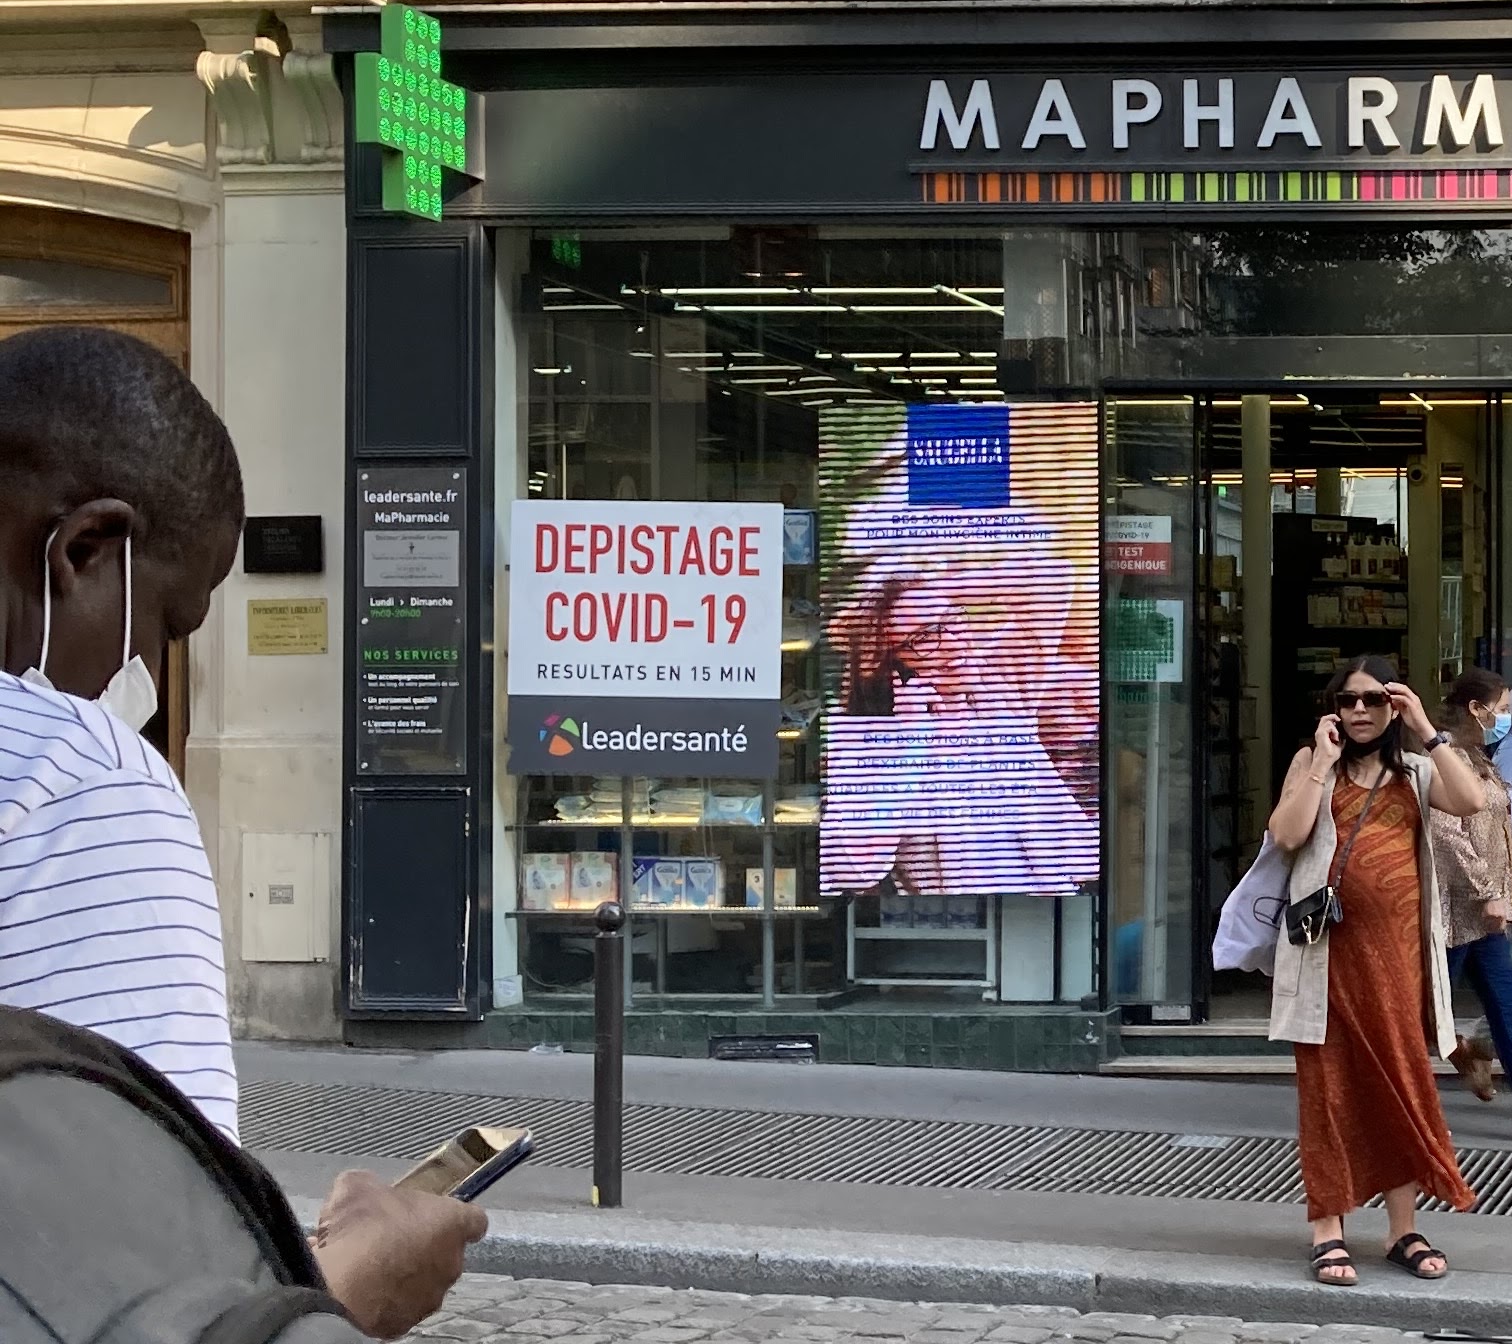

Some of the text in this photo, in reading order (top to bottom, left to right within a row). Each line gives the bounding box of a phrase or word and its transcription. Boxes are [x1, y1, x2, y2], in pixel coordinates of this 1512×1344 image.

[364, 490, 458, 503] leadersante.fr
[374, 512, 450, 524] MaPharmacie
[535, 524, 761, 577] DEPISTAGE
[1118, 546, 1144, 556] TEST
[370, 598, 454, 606] Lundi Dimanche
[545, 592, 748, 644] COVID-19
[364, 650, 458, 660] NOS SERVICES
[537, 664, 756, 682] RESULTATS EN 15 MIN
[582, 721, 748, 753] leadersanté
